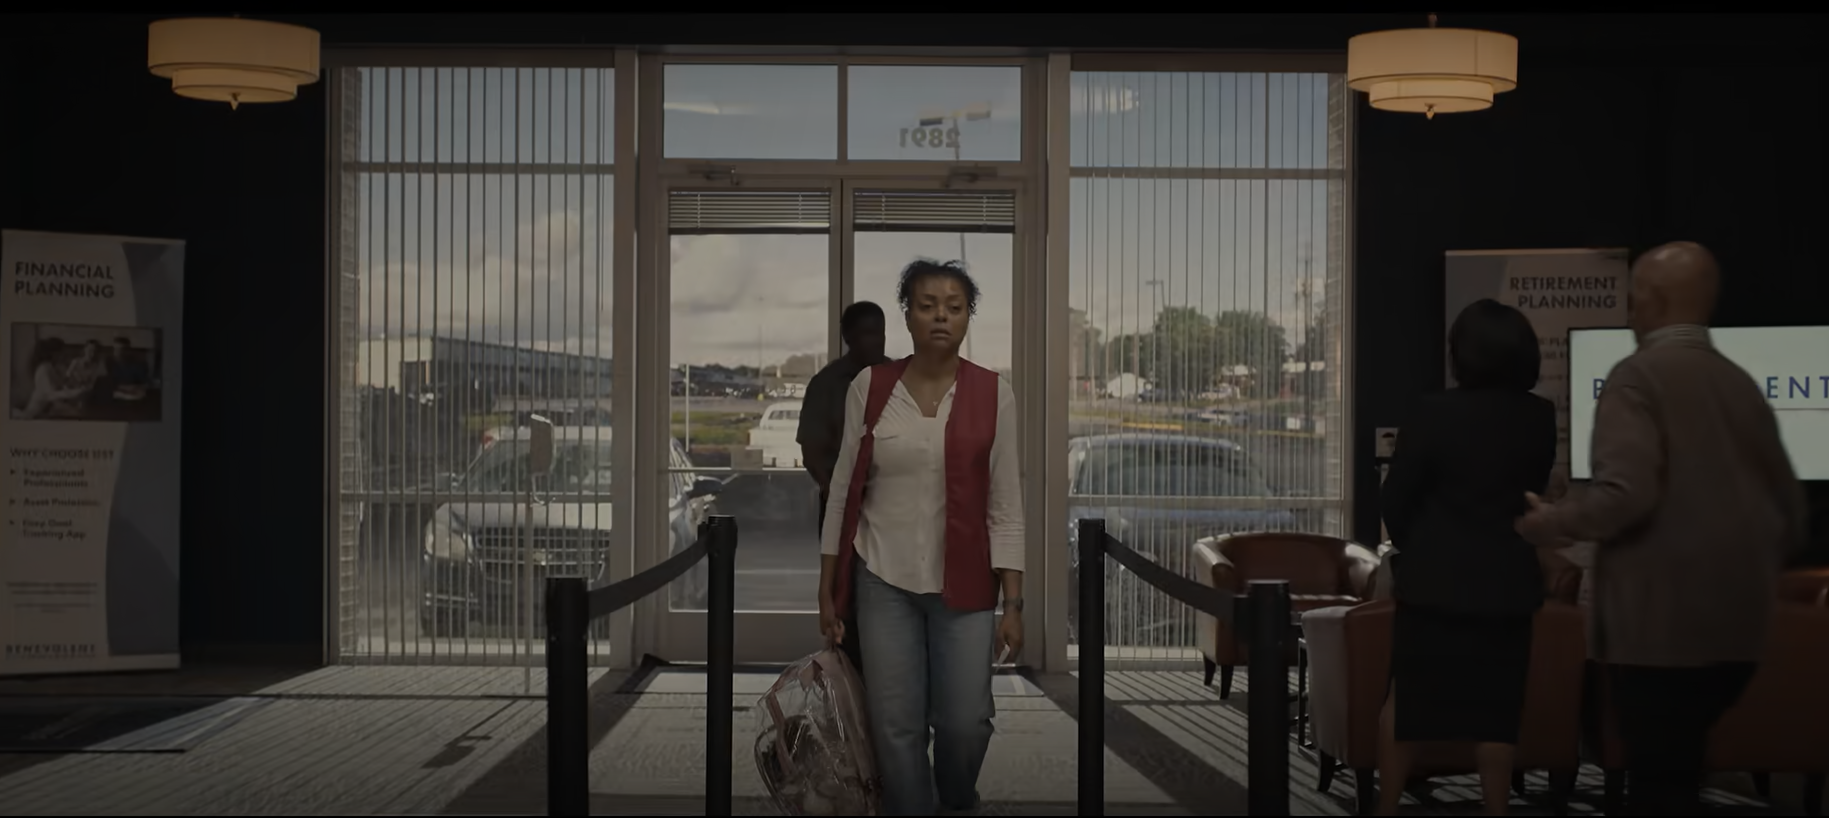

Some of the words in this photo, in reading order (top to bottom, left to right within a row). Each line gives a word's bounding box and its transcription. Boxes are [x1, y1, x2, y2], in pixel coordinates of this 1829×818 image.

[15, 261, 114, 280] FINANCIAL
[15, 280, 114, 299] PLANNING
[1509, 276, 1617, 290] RETIREMENT
[1518, 295, 1617, 309] PLANNING
